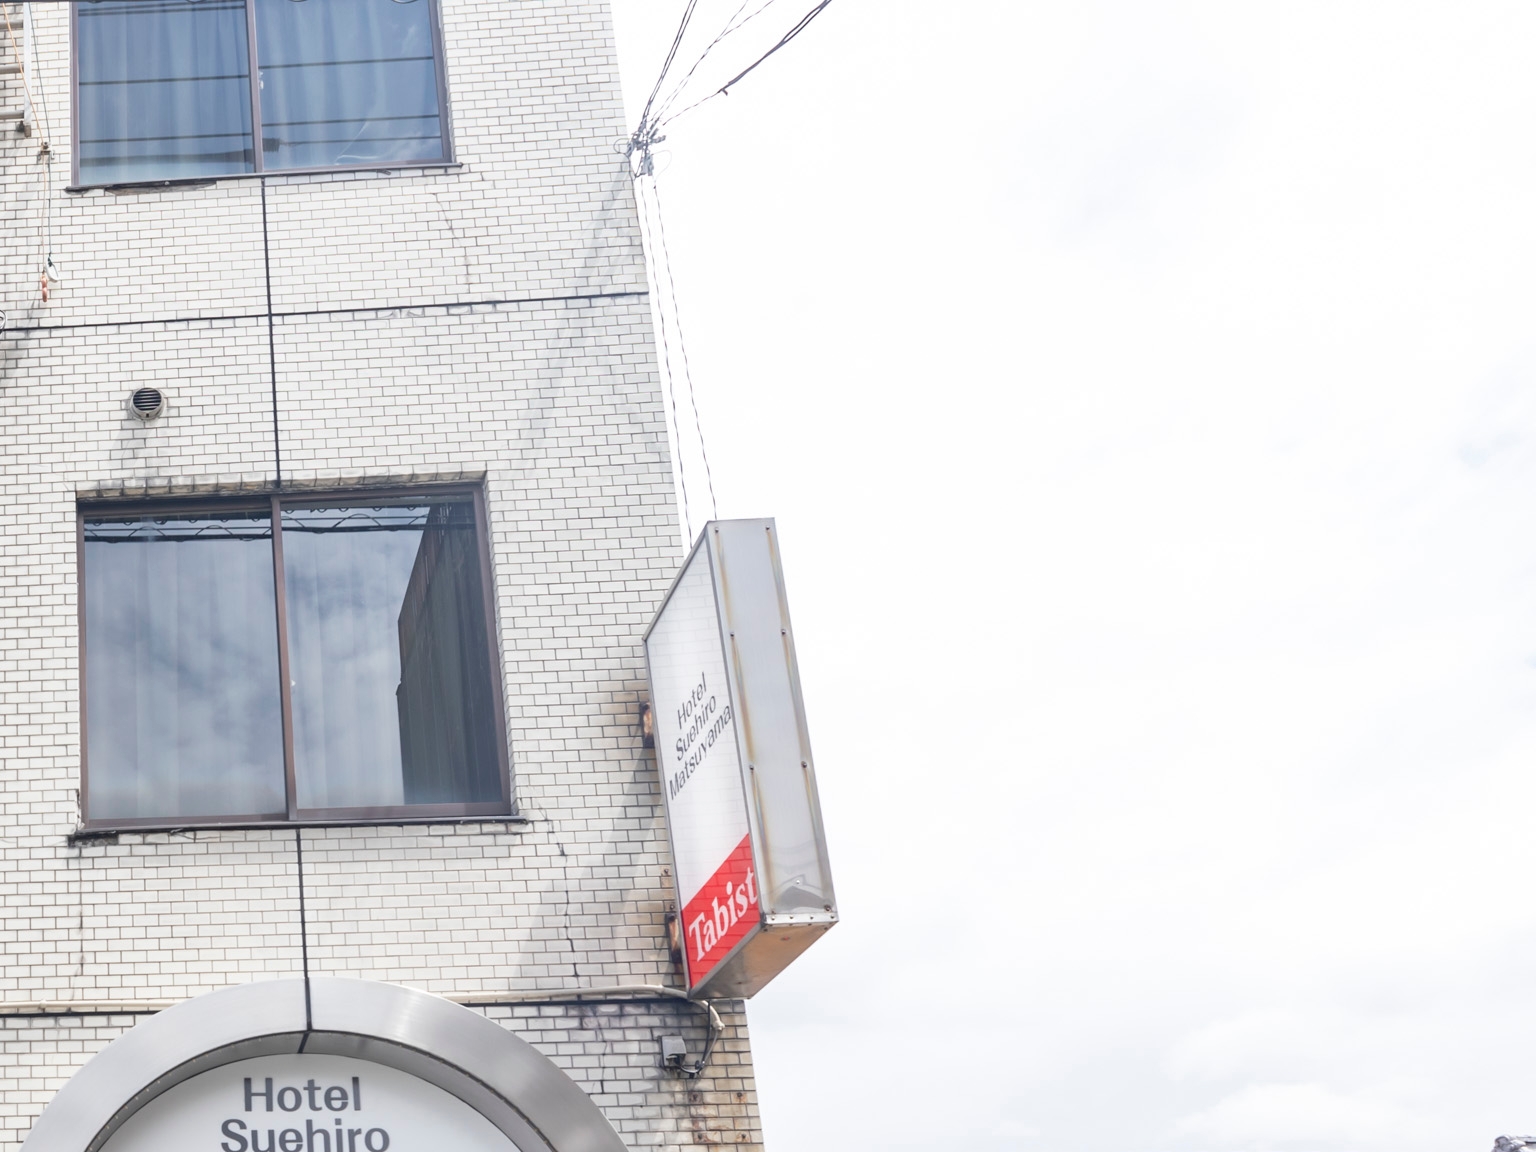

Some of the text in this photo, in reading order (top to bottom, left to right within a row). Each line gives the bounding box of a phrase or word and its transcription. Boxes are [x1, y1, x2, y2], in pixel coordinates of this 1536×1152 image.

[675, 695, 717, 761] Suehiro
[677, 671, 707, 730] Hotel
[669, 705, 731, 800] Matsuyama
[688, 866, 759, 962] Tabist
[243, 1076, 361, 1112] Hotel
